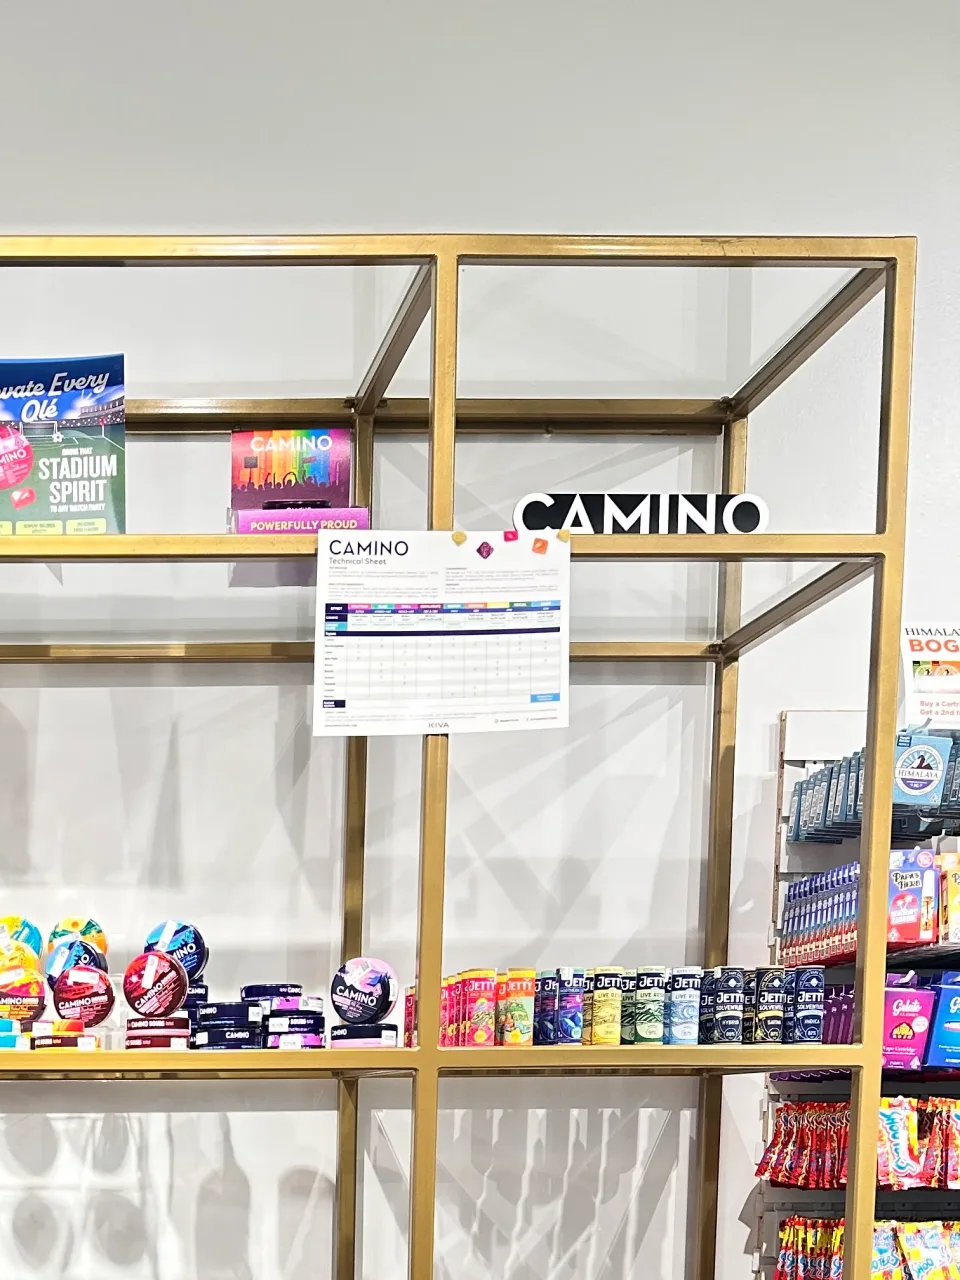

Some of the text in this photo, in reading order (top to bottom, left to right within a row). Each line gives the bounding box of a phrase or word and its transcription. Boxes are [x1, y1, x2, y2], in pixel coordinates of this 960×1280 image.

[48, 372, 110, 397] Every
[21, 398, 59, 423] Olé
[250, 435, 333, 451] CAMINO
[38, 454, 118, 480] STADIUM
[49, 479, 107, 504] SPIRIT
[513, 492, 770, 534] CAMINO
[250, 519, 358, 531] POWERFULLY PROUD
[329, 539, 409, 557] CAMINO
[329, 557, 387, 566] Technical Sheet
[919, 700, 934, 709] Buy
[428, 721, 450, 729] KIVA
[897, 768, 940, 779] HIMALAYA
[468, 978, 496, 992] JETTY
[506, 978, 533, 992] JETTY
[134, 981, 164, 1009] CAMINO
[336, 985, 377, 1006] CAMINO
[58, 998, 91, 1010] CAMINO
[892, 999, 922, 1014] Gelato
